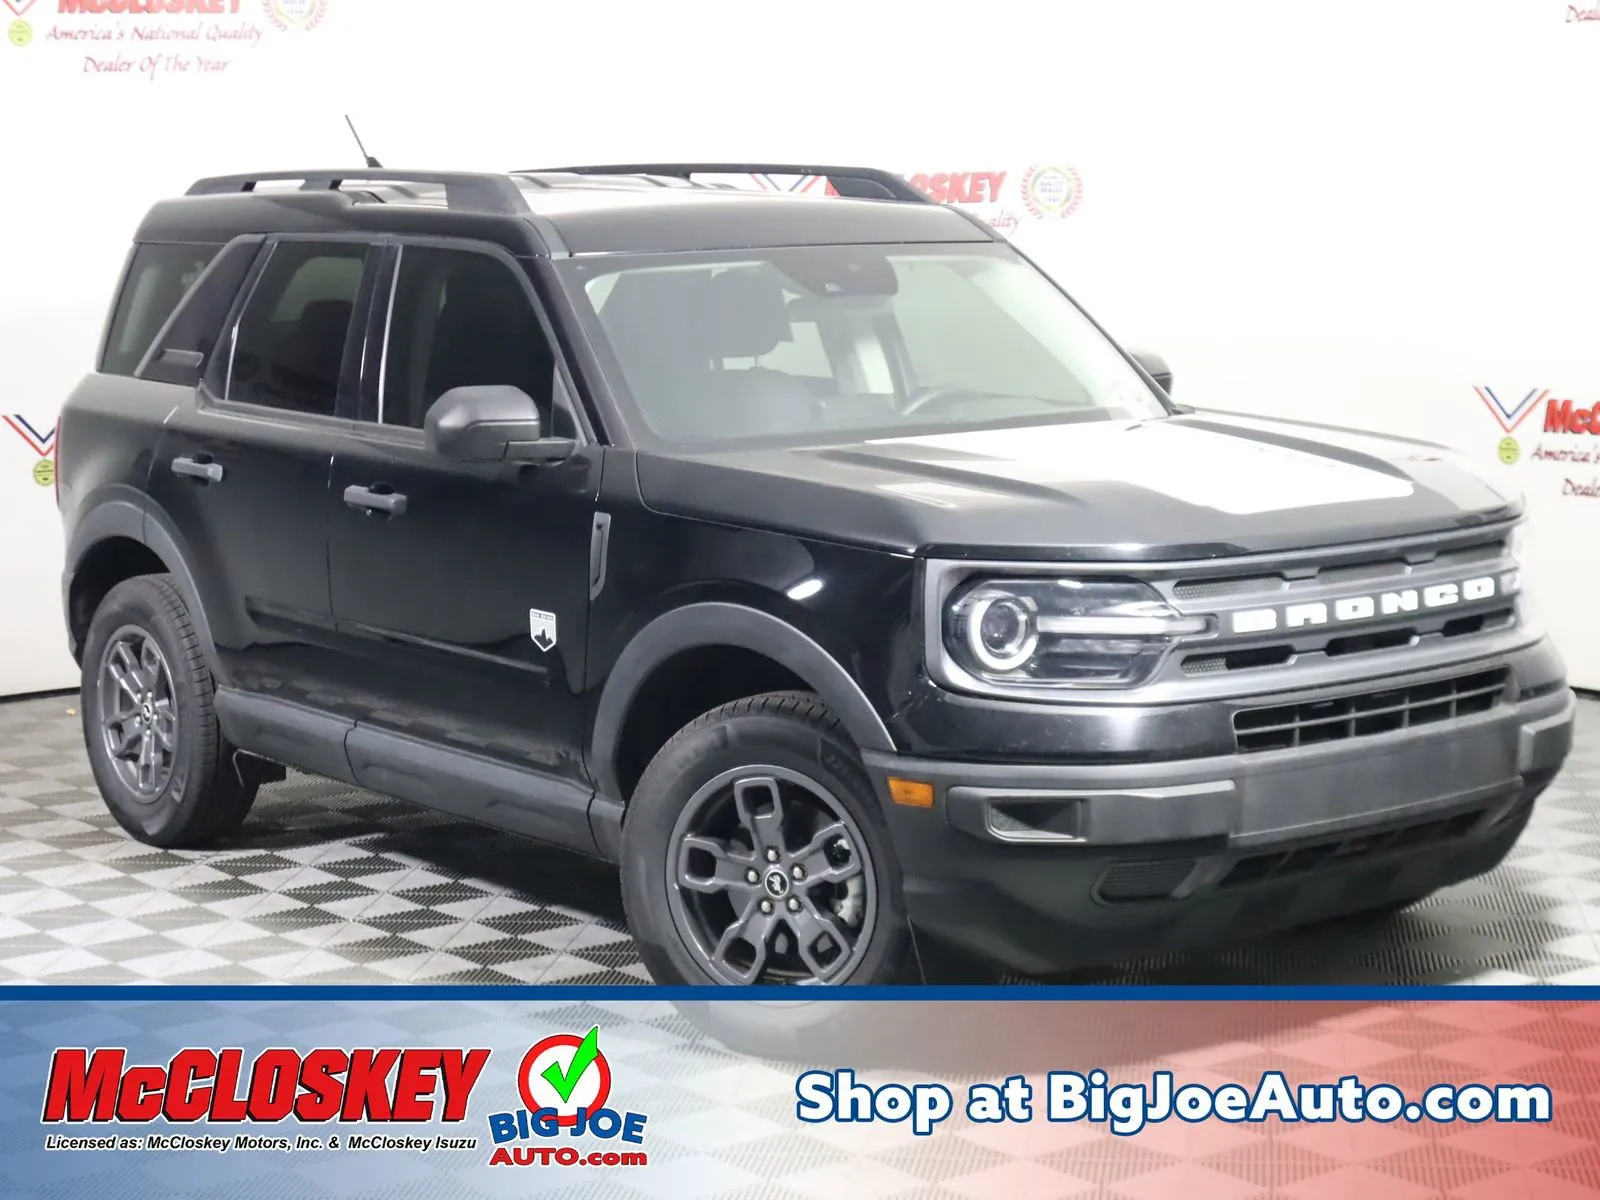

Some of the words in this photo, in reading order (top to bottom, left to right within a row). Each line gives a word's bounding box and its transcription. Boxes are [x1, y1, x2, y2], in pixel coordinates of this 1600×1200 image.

[45, 22, 124, 41] America's
[130, 21, 203, 42] National
[205, 21, 263, 49] Quality
[82, 53, 135, 74] Dealer
[139, 53, 163, 82] Of
[164, 53, 190, 73] The
[197, 55, 231, 73] Year
[1232, 576, 1495, 633] BRONCO
